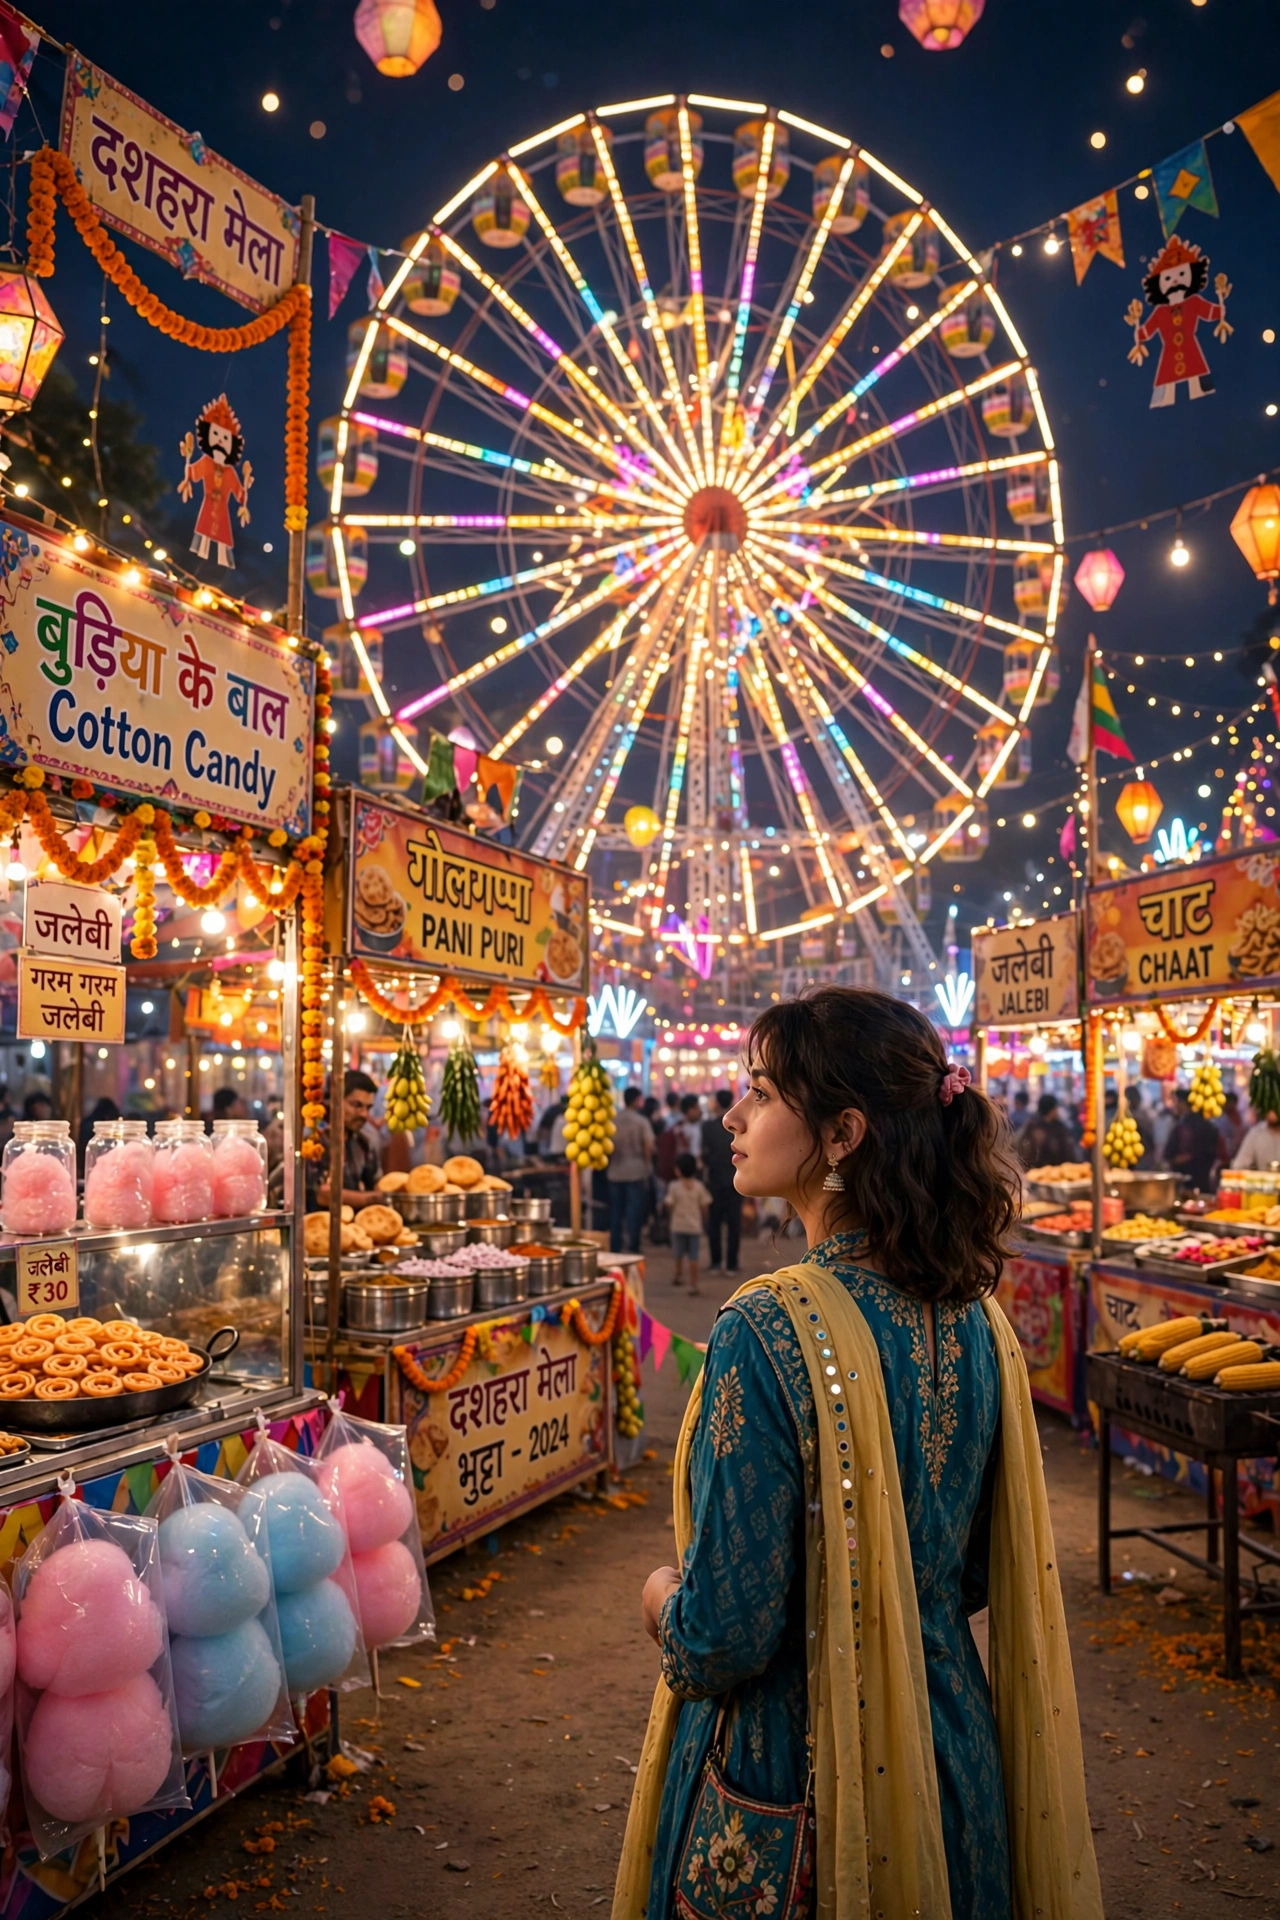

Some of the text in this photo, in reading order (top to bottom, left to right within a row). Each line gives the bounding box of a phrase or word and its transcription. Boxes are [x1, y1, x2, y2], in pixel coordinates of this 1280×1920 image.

[90, 115, 285, 287] दशहरा मेला
[36, 591, 289, 740] बुड़िया के बाल
[49, 689, 276, 810] Cotton Candy
[34, 903, 113, 950] जलेबी
[1138, 879, 1216, 941] चाट
[422, 913, 524, 967] PANI PURI
[991, 933, 1055, 985] जलेबी
[1139, 944, 1214, 984] CHAAT
[30, 968, 117, 997] गरम गरम
[998, 987, 1050, 1016] JALEBI
[41, 998, 105, 1032] जलेबी
[26, 1252, 71, 1276] जलेबी
[28, 1280, 68, 1304] ₹30
[448, 1347, 577, 1436] दशहरा मेला
[511, 1449, 522, 1457] -
[529, 1413, 569, 1462] 2024
